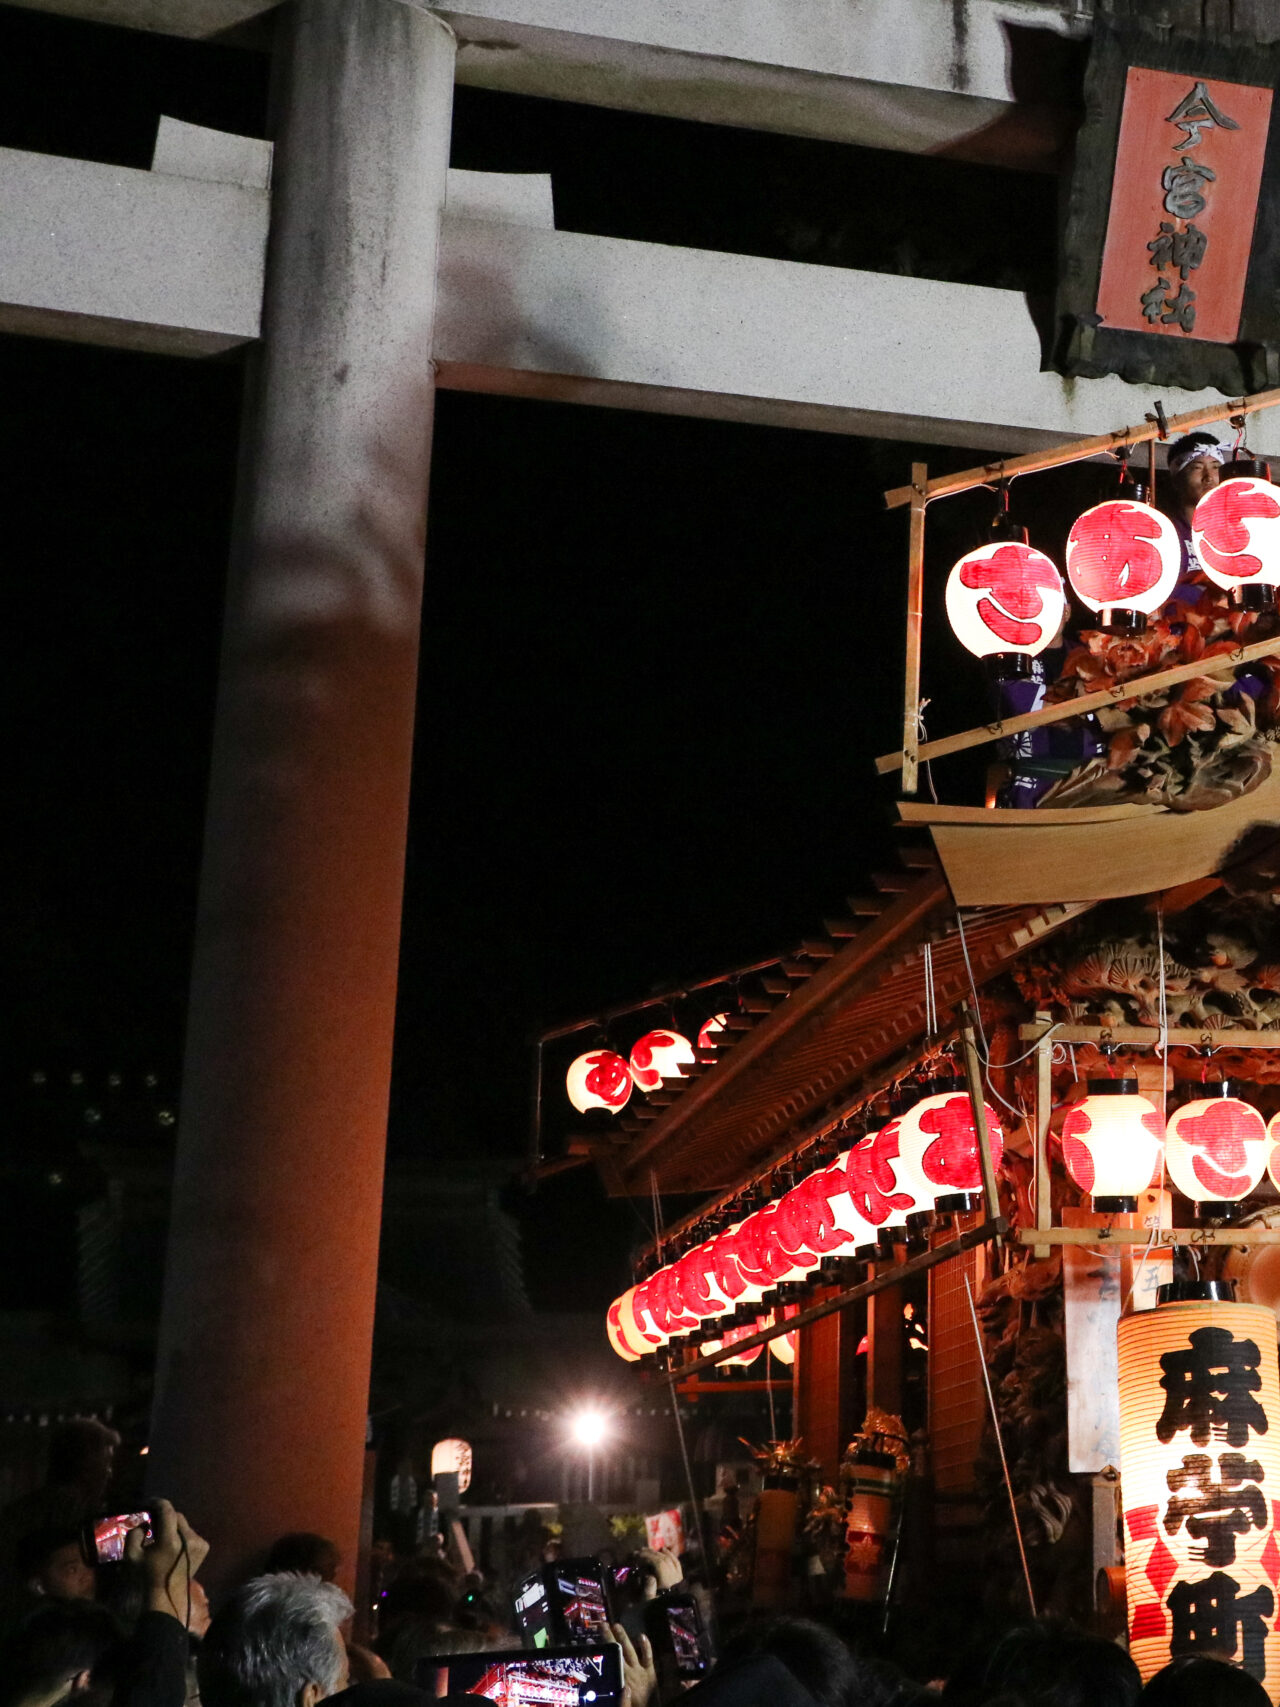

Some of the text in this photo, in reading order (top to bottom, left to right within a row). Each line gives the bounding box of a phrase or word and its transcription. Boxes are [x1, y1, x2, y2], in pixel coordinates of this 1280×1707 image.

[1140, 81, 1241, 333] 今宮神社
[960, 544, 1063, 645] さ
[1176, 1101, 1266, 1197] さ
[1156, 1326, 1276, 1684] 麻苧町
